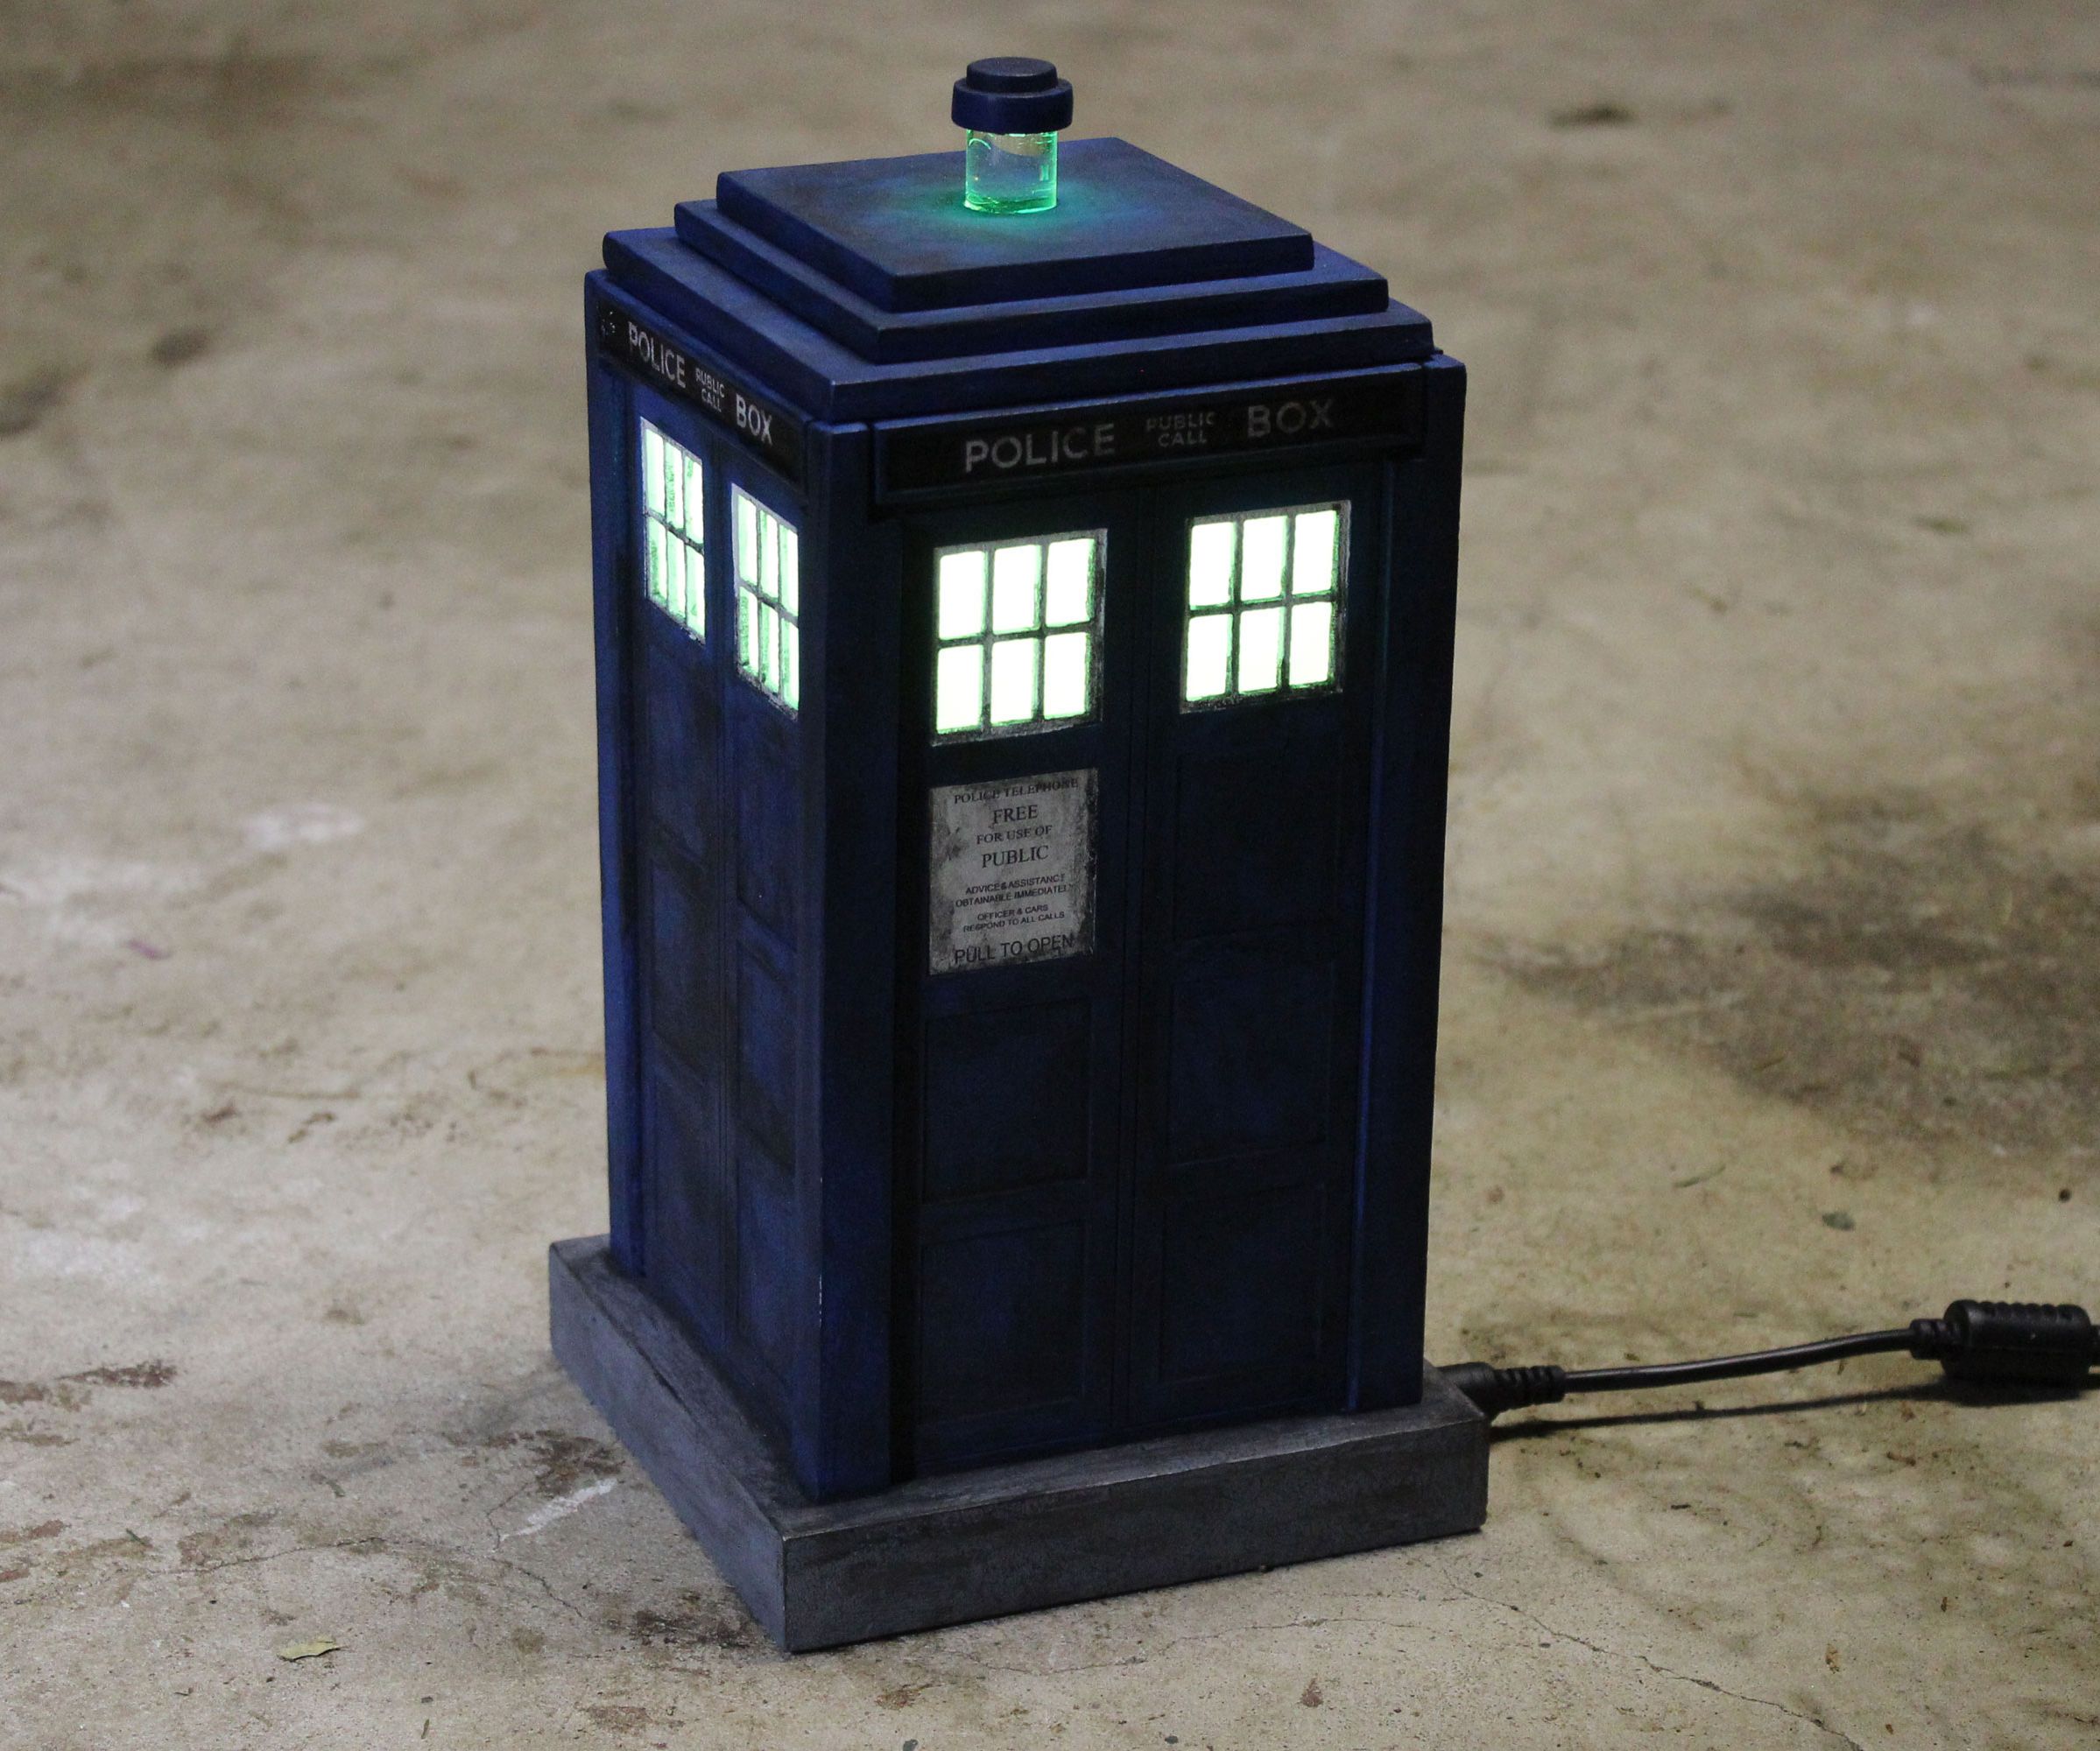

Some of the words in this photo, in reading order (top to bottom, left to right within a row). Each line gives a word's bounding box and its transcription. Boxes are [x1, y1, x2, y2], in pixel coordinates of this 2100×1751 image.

[628, 321, 686, 389] POLICE
[695, 368, 725, 398] PUBLIC
[701, 390, 722, 412] CALL
[736, 393, 773, 446] BOX
[1145, 411, 1216, 432] PUBLIC
[1247, 398, 1335, 438] BOX
[965, 423, 1115, 472] POLICE
[1158, 429, 1207, 448] CALL
[955, 790, 999, 804] POLICE
[1004, 778, 1078, 797] TELEPHONE
[993, 805, 1038, 824] FREE
[976, 833, 1004, 845] FOR
[1006, 827, 1032, 840] USE
[1035, 825, 1053, 836] OF
[982, 845, 1048, 868] PUBLIC
[955, 893, 1011, 908] OBTAINABLE
[1014, 883, 1074, 899] IMMEDIATELY
[966, 883, 1000, 895] ADVICE
[963, 920, 1005, 932] RESPOND
[1008, 918, 1019, 926] TO
[1020, 915, 1036, 925] ALL
[1038, 911, 1065, 922] CALLS
[976, 909, 1015, 920] OFFICER
[1025, 904, 1049, 915] CARS
[955, 945, 995, 964] PULL
[1001, 940, 1023, 957] TO
[1027, 933, 1075, 953] OPEN
